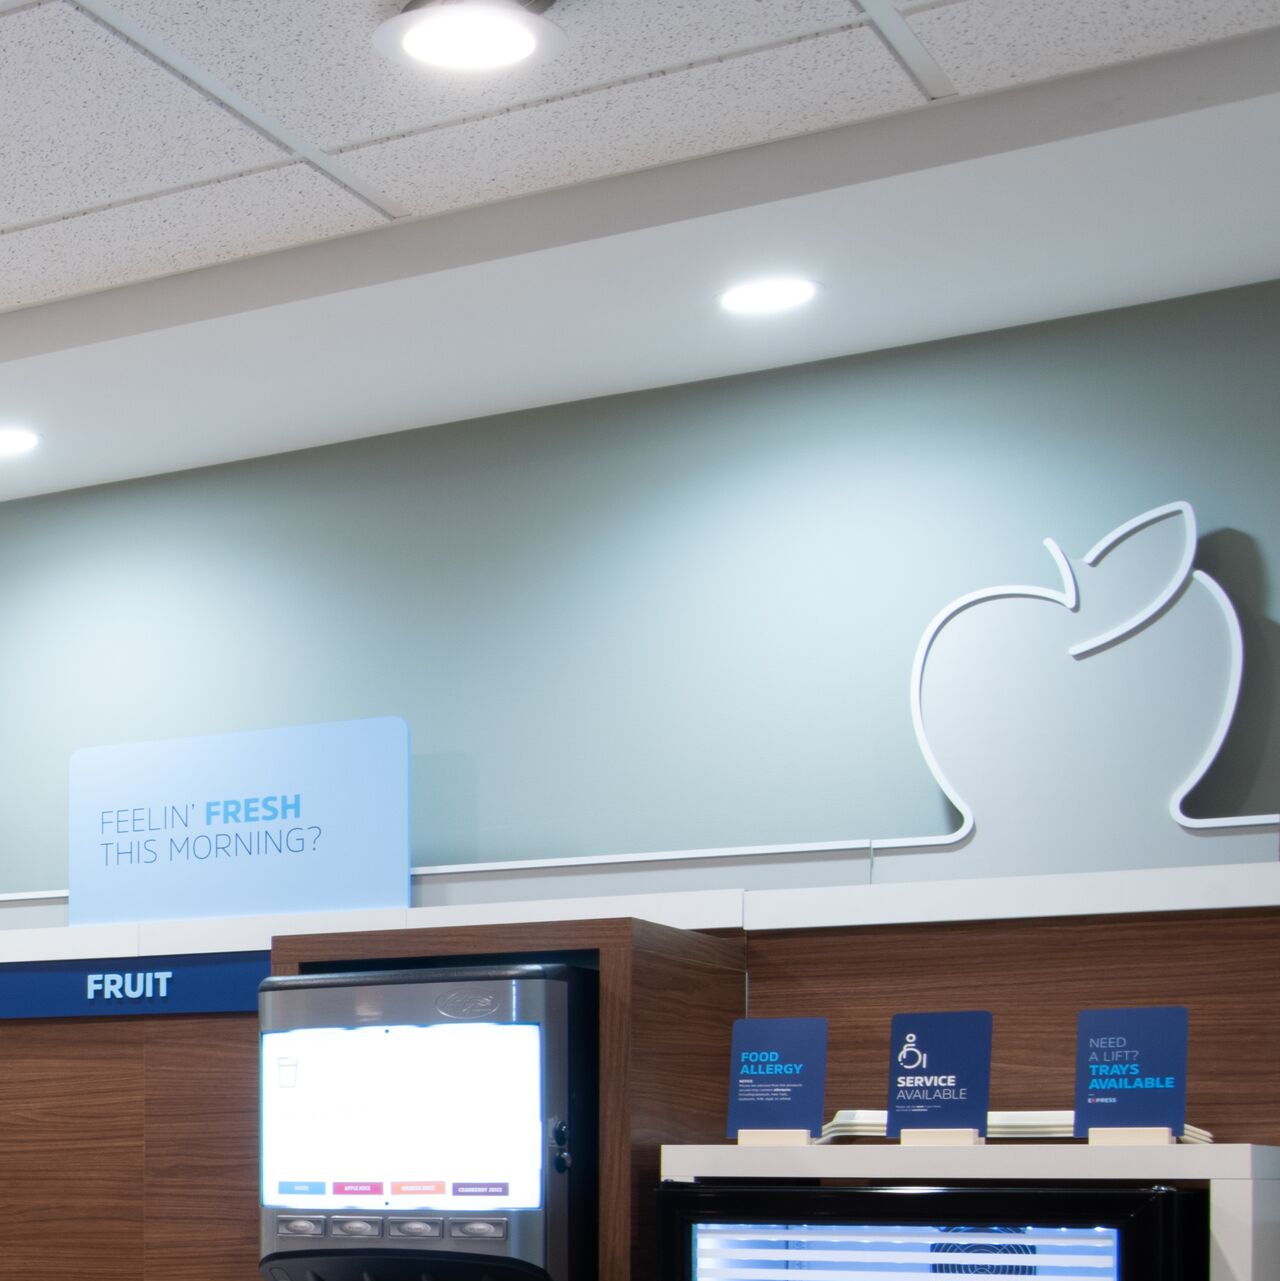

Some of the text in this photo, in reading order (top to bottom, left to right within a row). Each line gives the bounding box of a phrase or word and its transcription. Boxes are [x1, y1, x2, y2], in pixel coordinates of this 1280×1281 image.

[205, 794, 302, 827] FRESH
[100, 825, 323, 867] THIS MORNING?
[86, 970, 173, 1001] FRUIT
[1089, 1036, 1127, 1048] NEED
[741, 1051, 779, 1062] FOOD
[1088, 1050, 1139, 1061] A LIFT?
[740, 1063, 803, 1074] ALLERGY
[1089, 1063, 1140, 1075] TRAYS
[897, 1075, 956, 1087] SERVICE
[1088, 1077, 1175, 1089] AVAILABLE
[896, 1088, 968, 1100] AVAILABLE
